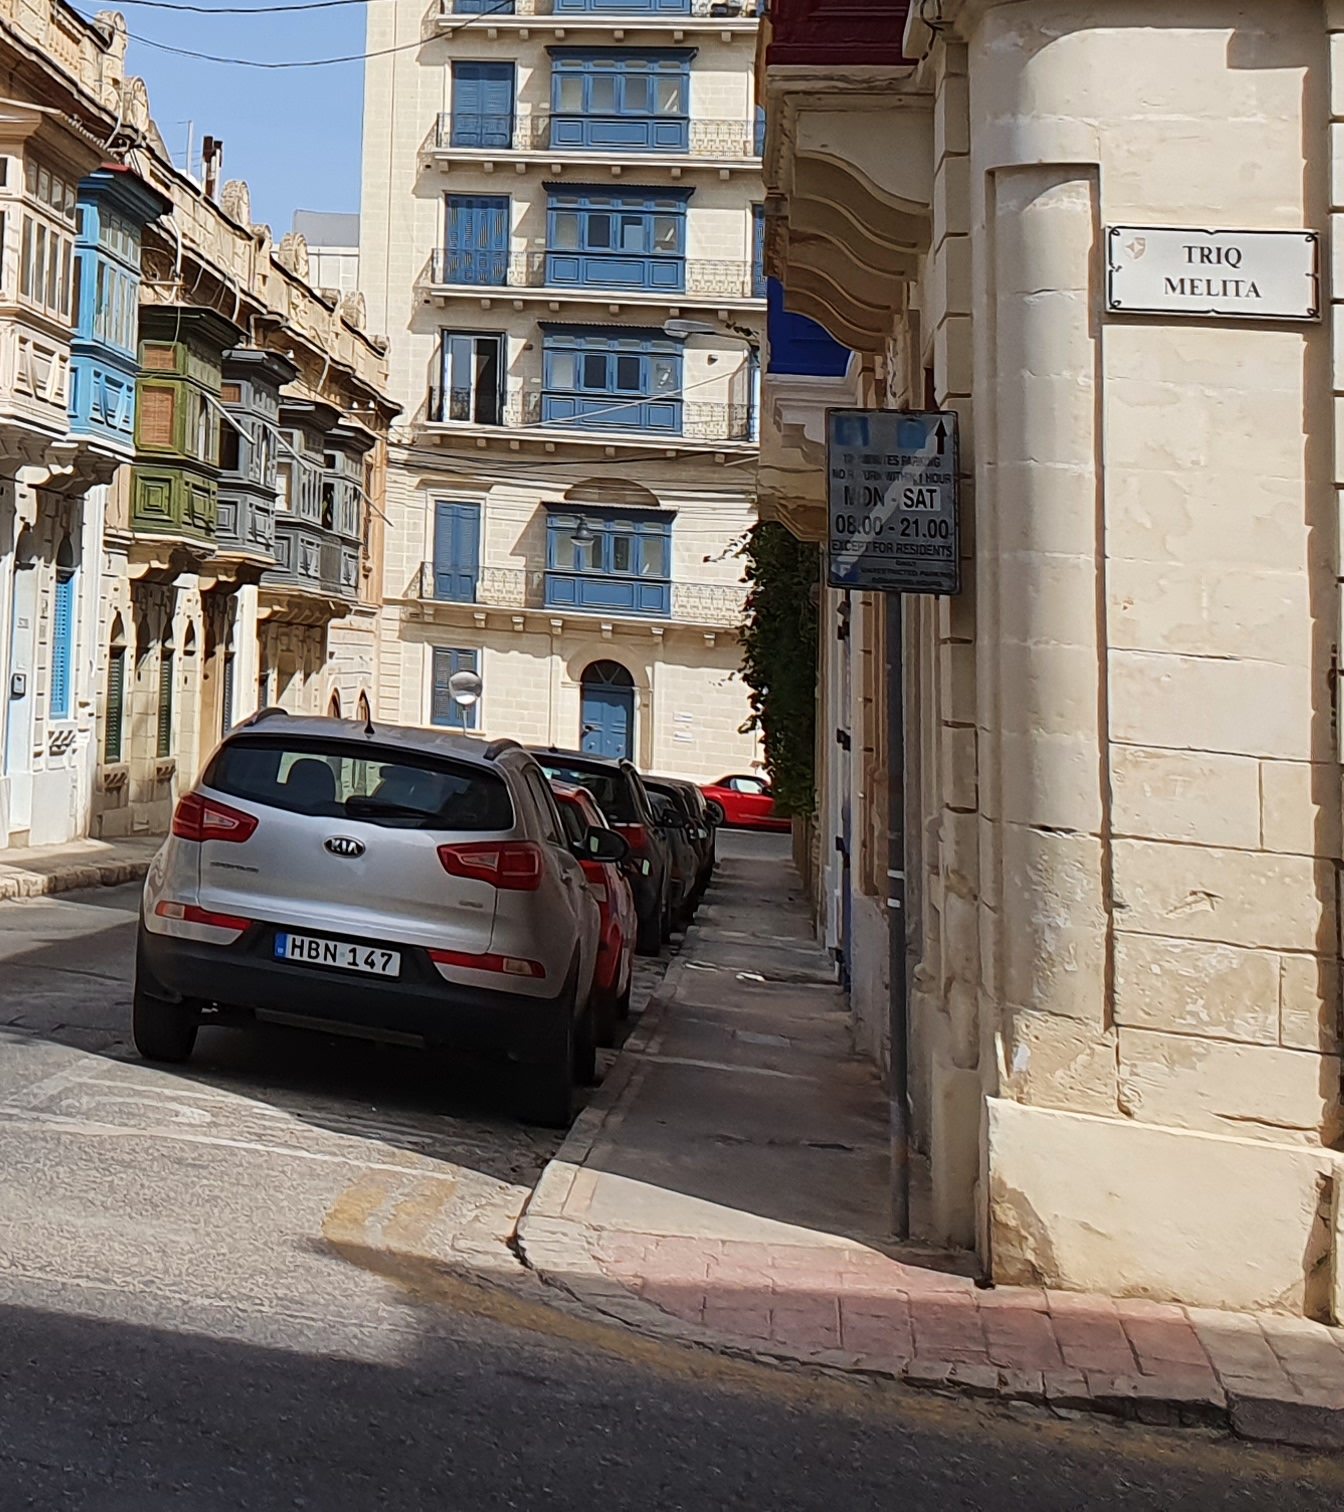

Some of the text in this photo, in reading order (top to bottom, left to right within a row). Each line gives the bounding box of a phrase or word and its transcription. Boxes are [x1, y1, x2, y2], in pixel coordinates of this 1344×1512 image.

[1183, 245, 1242, 268] TRIQ
[1164, 277, 1262, 299] MELITA
[925, 473, 951, 484] HOUR
[903, 487, 938, 509] SAT
[835, 514, 883, 536] 08.00
[900, 517, 949, 539] 21.00
[872, 542, 892, 554] FOR
[896, 543, 952, 557] RESIDENTS
[330, 839, 358, 854] KIA
[290, 937, 394, 972] HBN 147
